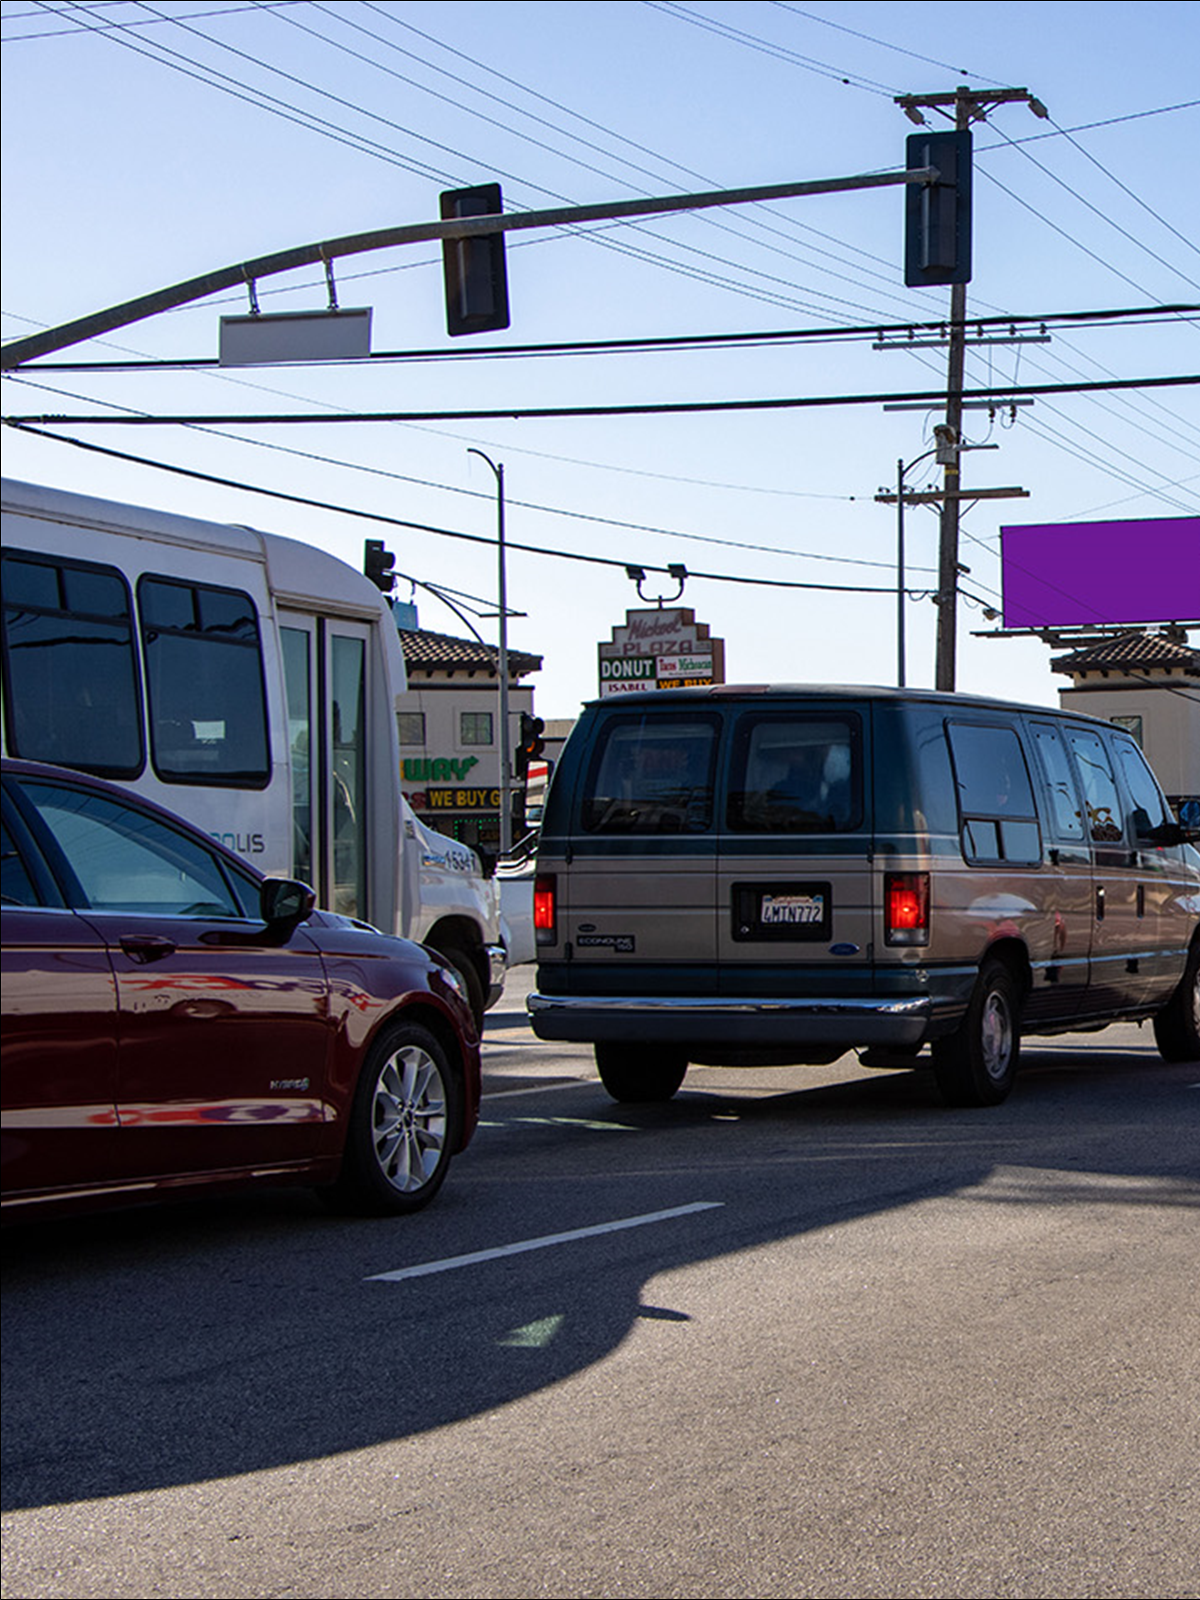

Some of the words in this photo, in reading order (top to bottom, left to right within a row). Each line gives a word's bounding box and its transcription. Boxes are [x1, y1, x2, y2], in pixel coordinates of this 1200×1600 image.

[622, 641, 693, 655] PLAZA
[601, 660, 653, 678] DONUT
[608, 683, 648, 692] ISABEL
[400, 757, 478, 782] WAY
[430, 790, 452, 807] WE
[457, 790, 487, 807] BUY
